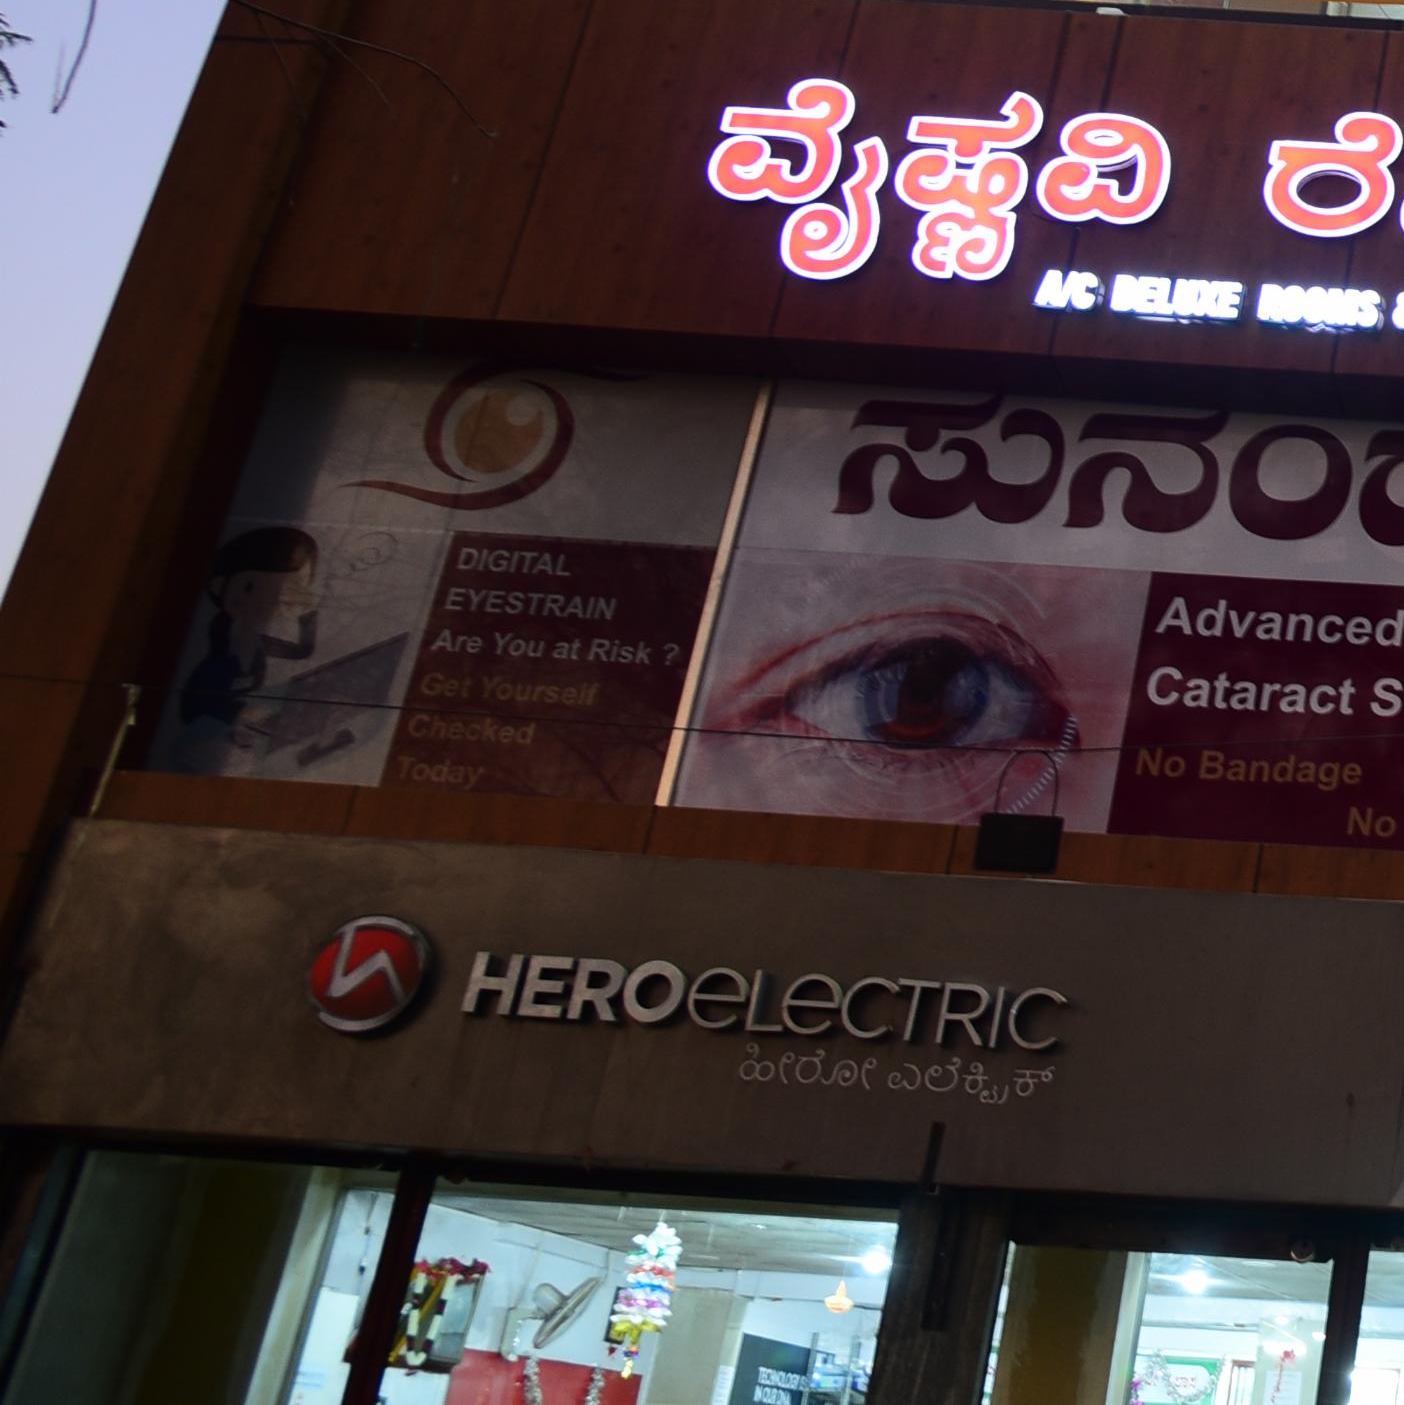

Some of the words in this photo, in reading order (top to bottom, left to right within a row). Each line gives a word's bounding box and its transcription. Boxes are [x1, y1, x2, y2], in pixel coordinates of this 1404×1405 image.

[708, 78, 1171, 280] ವೈಷ್ಣವಿ
[1034, 269, 1099, 310] A/C
[1110, 274, 1243, 319] DELUXE
[1257, 283, 1383, 329] ROOMS
[457, 548, 571, 576] DIGITAL
[444, 587, 616, 620] EYESTRAIN
[1155, 595, 1404, 648] Advanced
[430, 628, 483, 653] Are
[494, 632, 544, 658] You
[552, 640, 581, 660] at
[587, 638, 652, 665] Risk
[421, 673, 471, 698] Get
[481, 676, 600, 706] Yourself
[1145, 666, 1355, 717] Cataract
[409, 714, 536, 744] Checked
[396, 756, 484, 789] Today
[1134, 747, 1187, 778] No
[1200, 749, 1363, 793] Bandage
[1347, 805, 1396, 840] No
